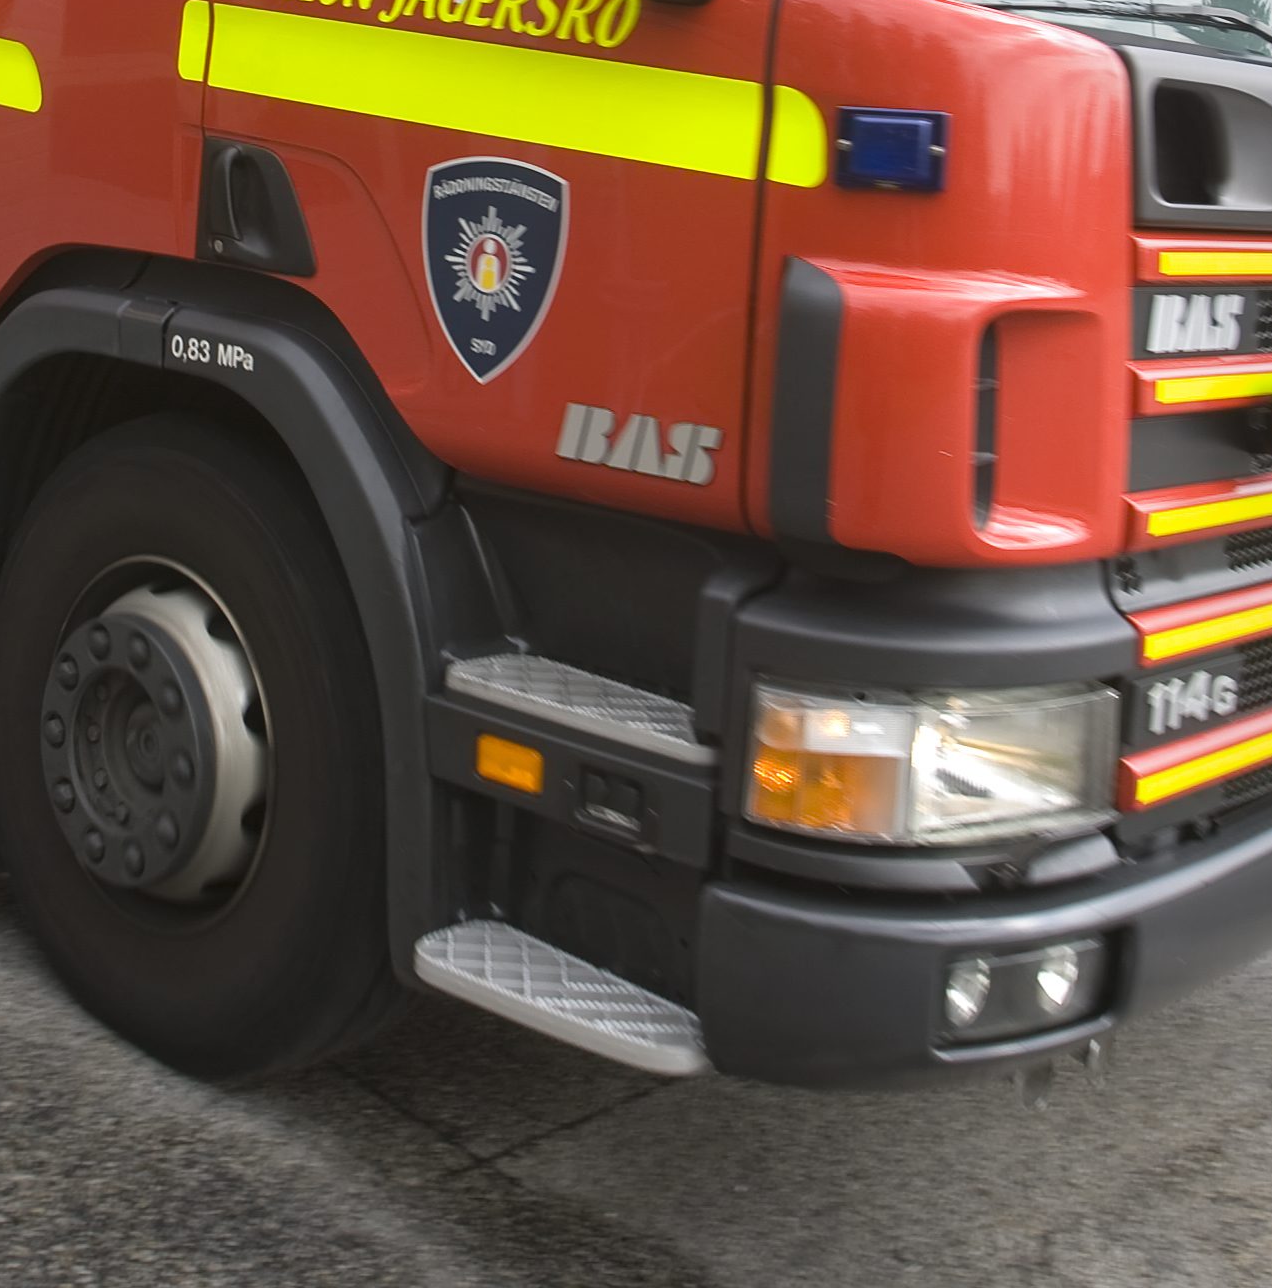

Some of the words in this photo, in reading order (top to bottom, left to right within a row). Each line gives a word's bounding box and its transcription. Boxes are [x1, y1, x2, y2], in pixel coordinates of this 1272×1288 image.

[171, 334, 211, 364] 0,83
[216, 342, 255, 372] MPa
[1146, 294, 1246, 353] BAS
[555, 402, 724, 487] BAS
[1147, 669, 1239, 736] 114G
